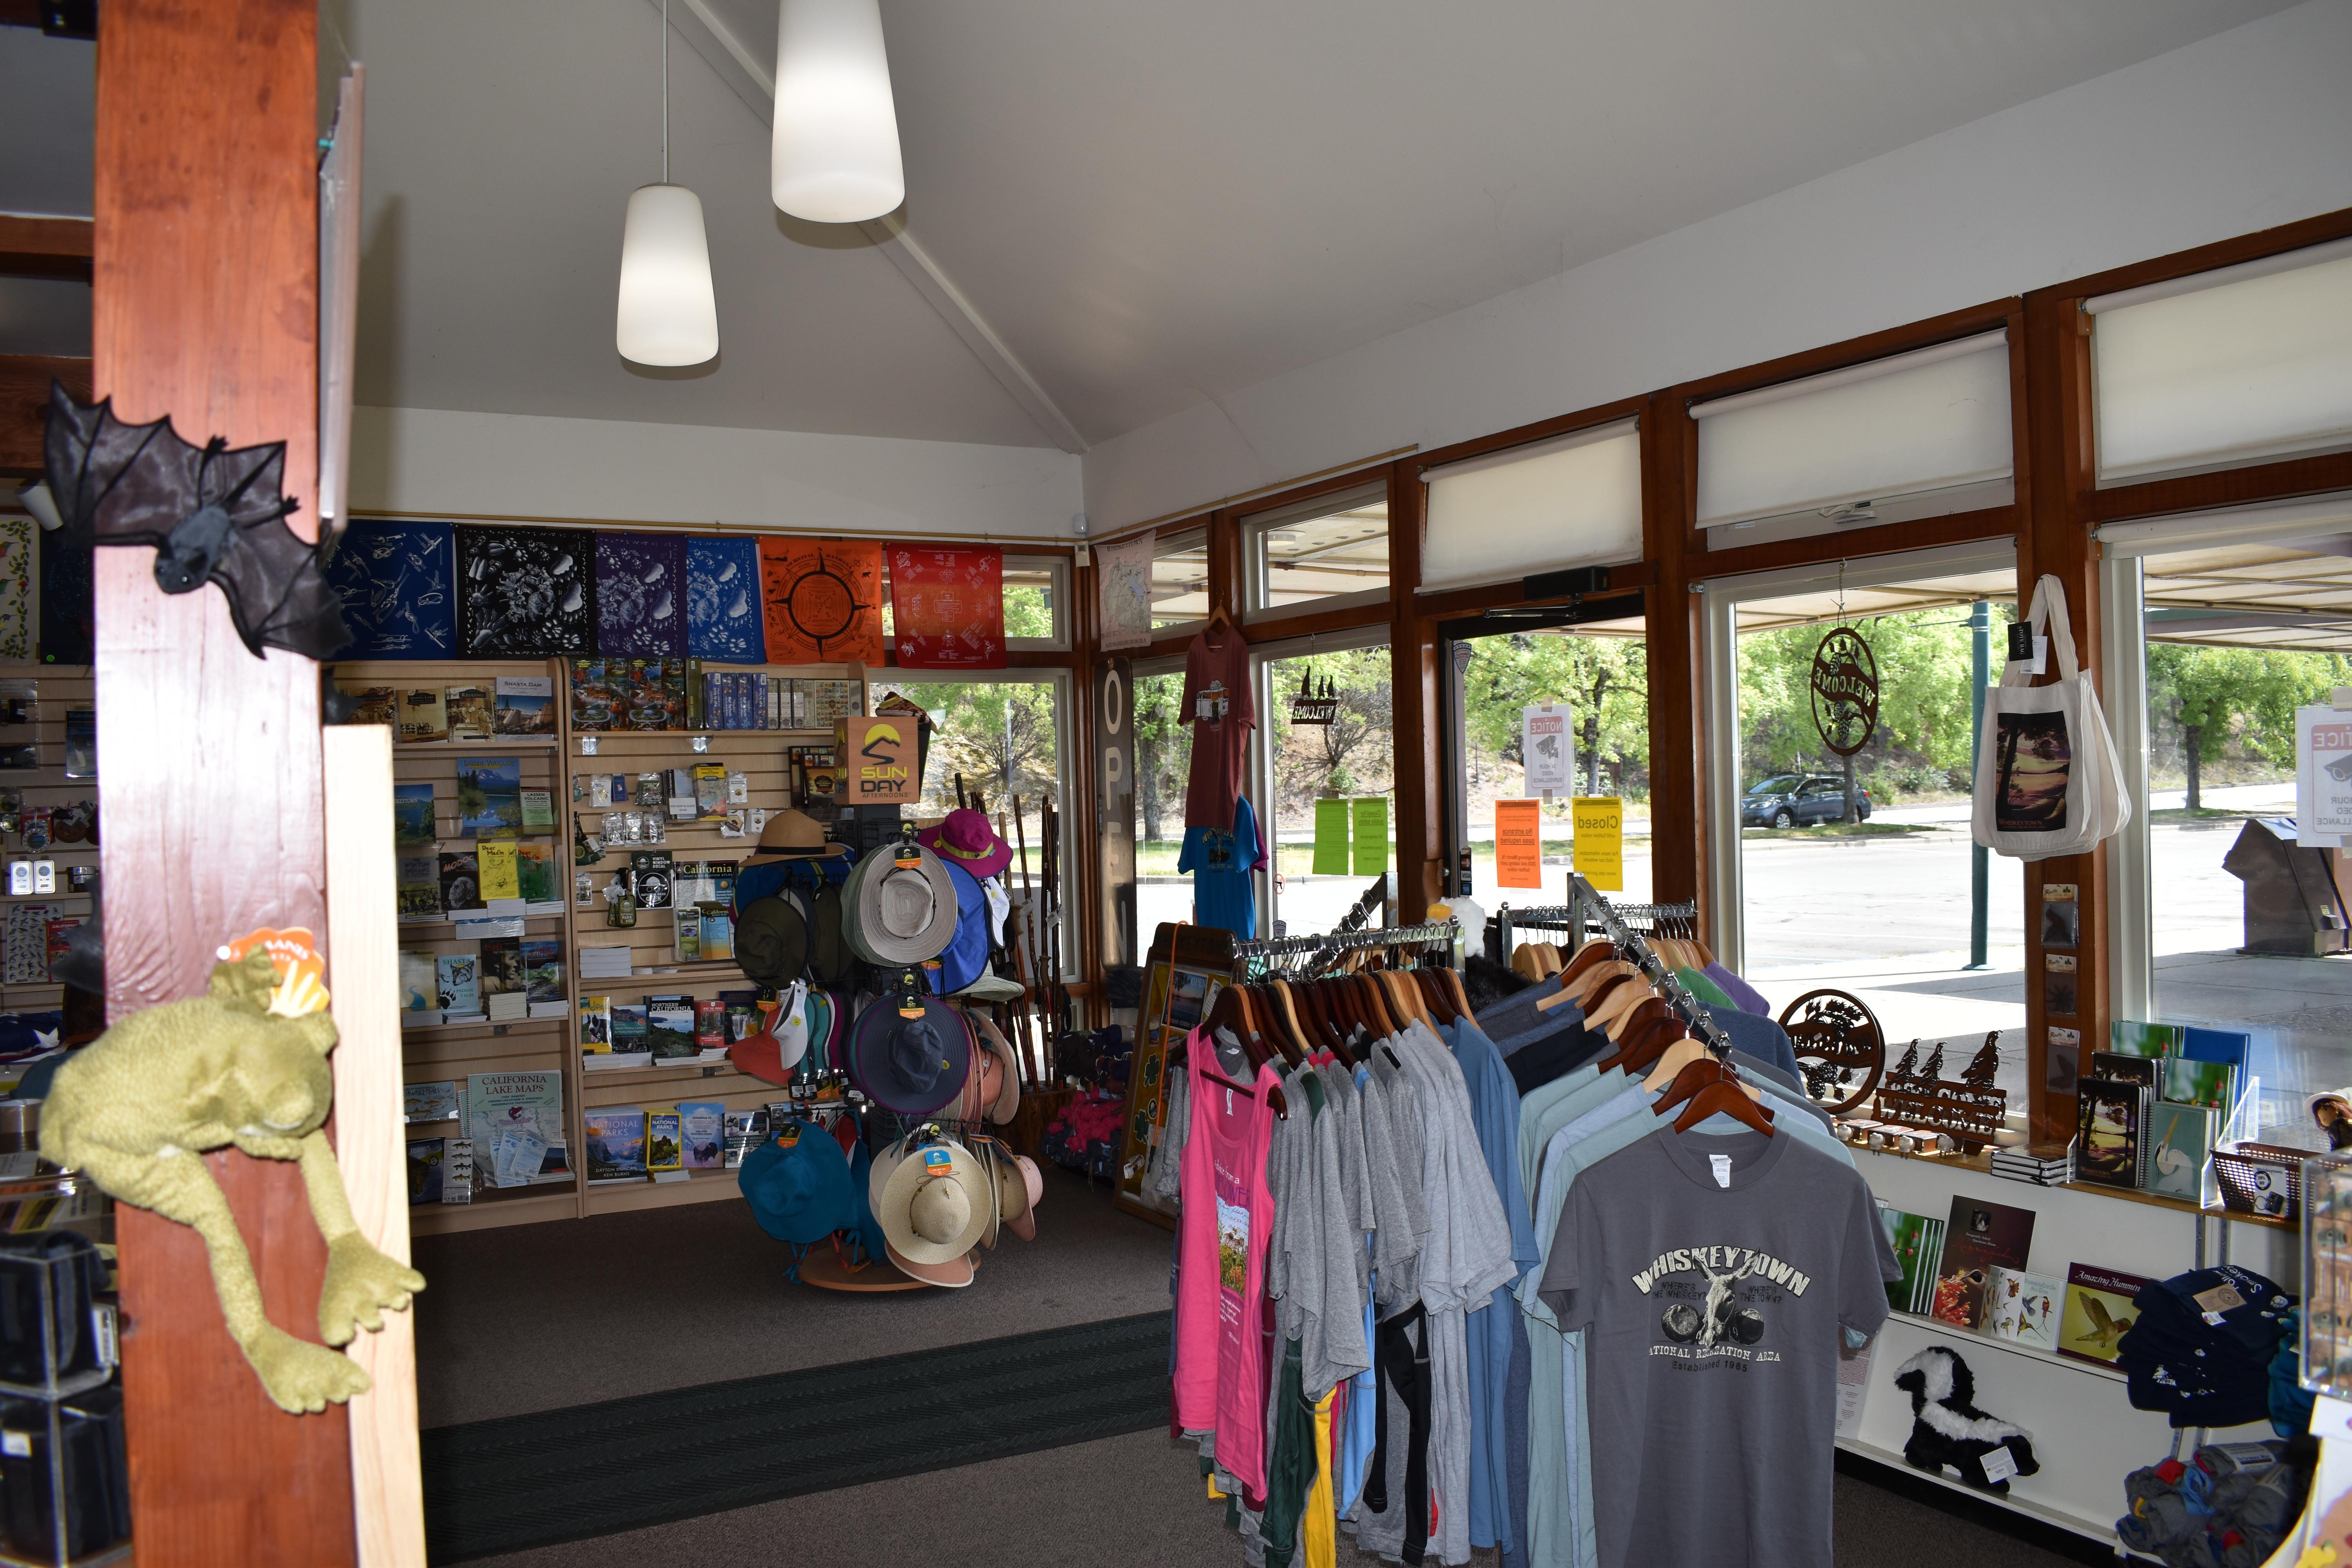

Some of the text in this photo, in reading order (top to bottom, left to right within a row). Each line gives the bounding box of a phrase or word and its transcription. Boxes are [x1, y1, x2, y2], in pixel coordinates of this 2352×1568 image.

[786, 553, 852, 569] SURVIVAL BANDANA
[861, 766, 907, 779] SUN
[861, 780, 907, 793] DAY
[443, 855, 474, 873] MODOC
[683, 864, 733, 875] California
[1191, 977, 1207, 989] OPEN
[1165, 1014, 1179, 1024] Pease
[482, 1076, 547, 1085] CALIFORNIA
[486, 1085, 544, 1095] LAKE MAPS
[1878, 1096, 1993, 1136] WELCOME
[591, 1120, 638, 1129] NATIONAL
[601, 1128, 629, 1136] PARKS
[2080, 1165, 2110, 1176] WHISKEYTOWN
[1631, 1245, 1811, 1298] WHISKEYTOWN
[1660, 1281, 1696, 1290] WHERE'S
[2075, 1270, 2109, 1286] Amazing
[2110, 1278, 2141, 1292] Hummin
[1666, 1289, 1706, 1300] WHISKEY?
[1747, 1285, 1777, 1294] WHERE'S
[1739, 1293, 1782, 1304] THE TOWN?
[1649, 1345, 1691, 1359] ATIONAL
[1756, 1352, 1781, 1362] AREA
[1671, 1359, 1748, 1372] Established 1965
